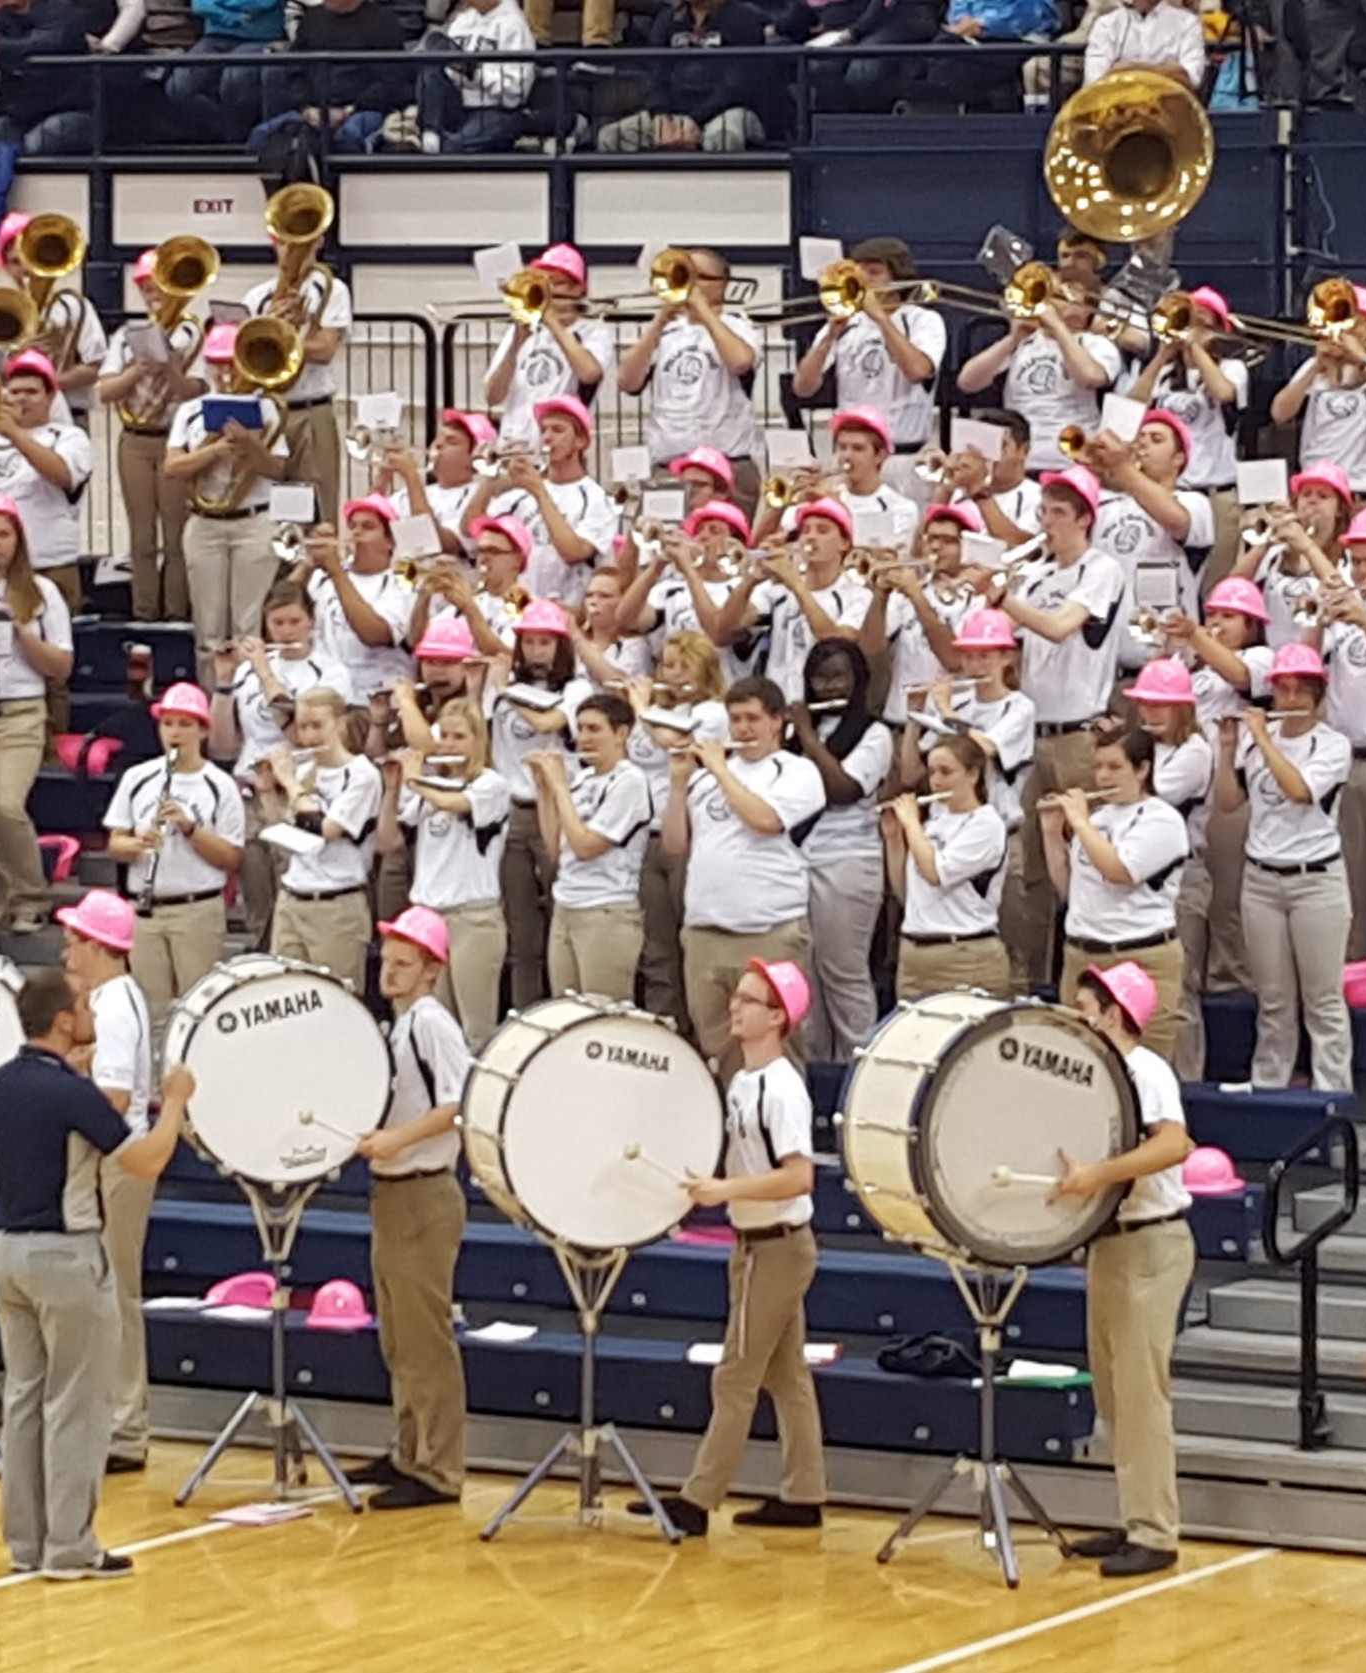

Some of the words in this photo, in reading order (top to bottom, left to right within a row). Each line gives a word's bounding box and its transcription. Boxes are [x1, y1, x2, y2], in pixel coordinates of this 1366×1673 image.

[193, 199, 234, 214] EXIT
[240, 989, 323, 1028] YAMAHA
[607, 1045, 670, 1073] YAMAHA
[1023, 1042, 1094, 1087] YAMAHA
